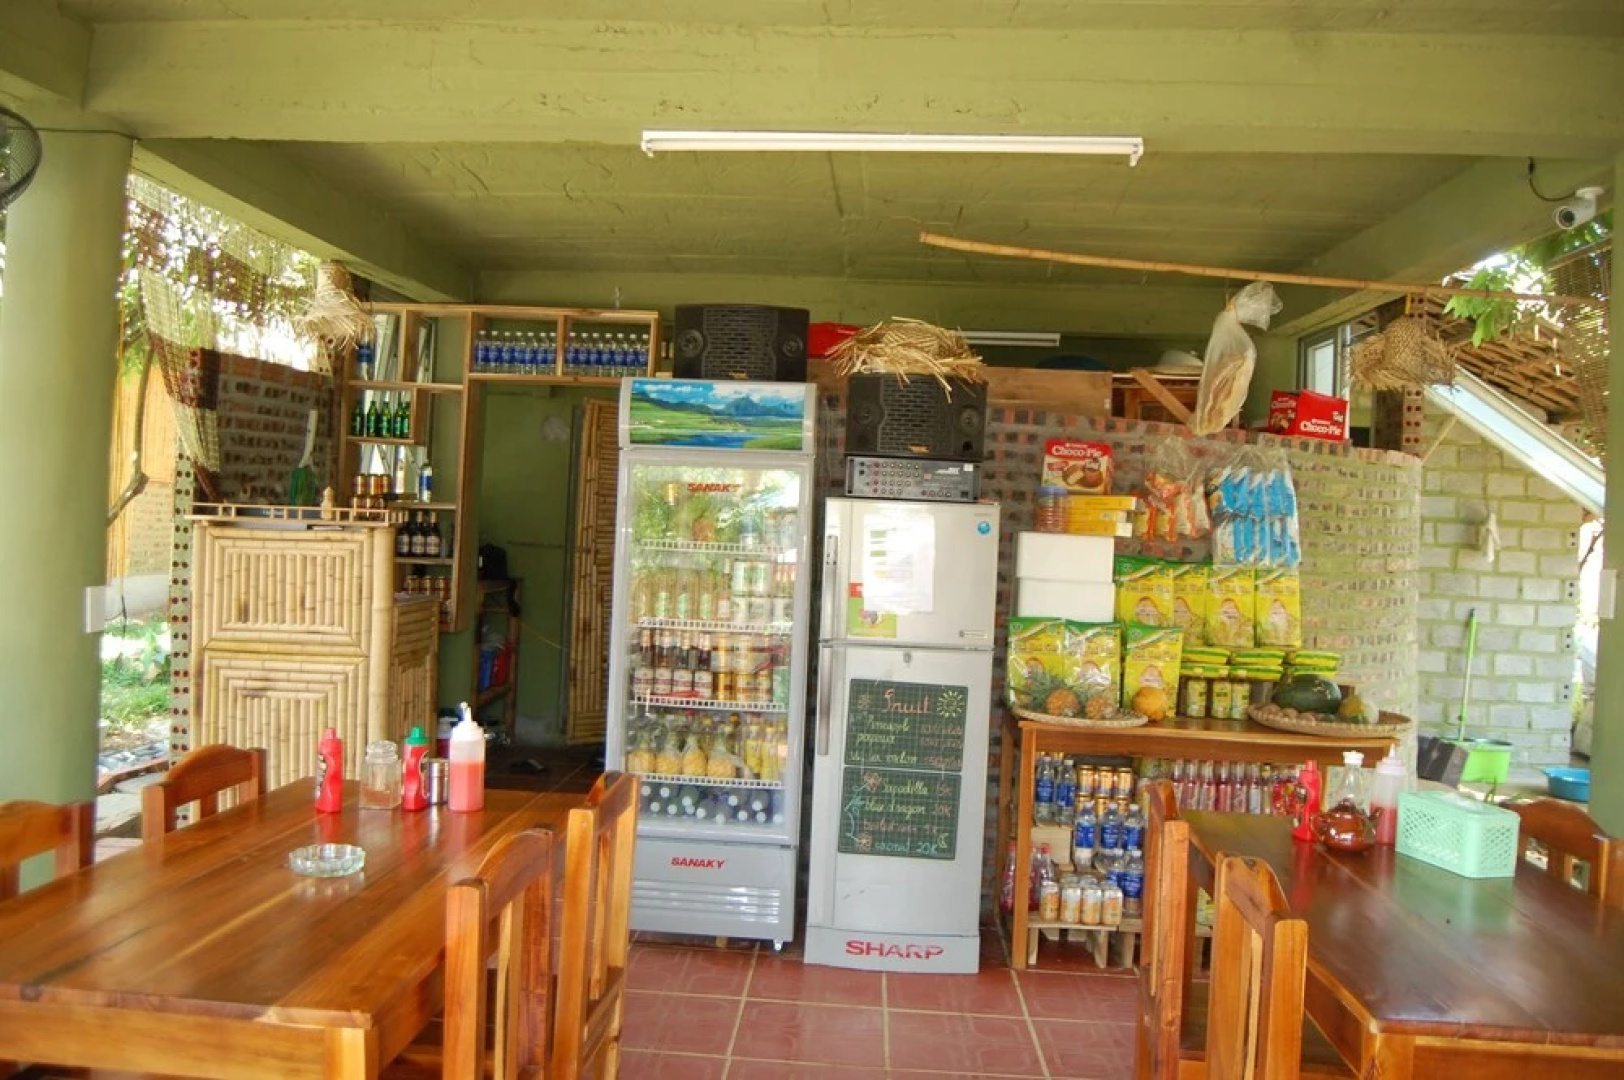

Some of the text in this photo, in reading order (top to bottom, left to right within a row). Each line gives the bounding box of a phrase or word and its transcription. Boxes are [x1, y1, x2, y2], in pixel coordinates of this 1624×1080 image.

[1300, 420, 1342, 435] Choco-Pie
[884, 689, 931, 713] Fruit
[671, 857, 725, 869] SANAKY
[845, 940, 945, 960] SHARP
